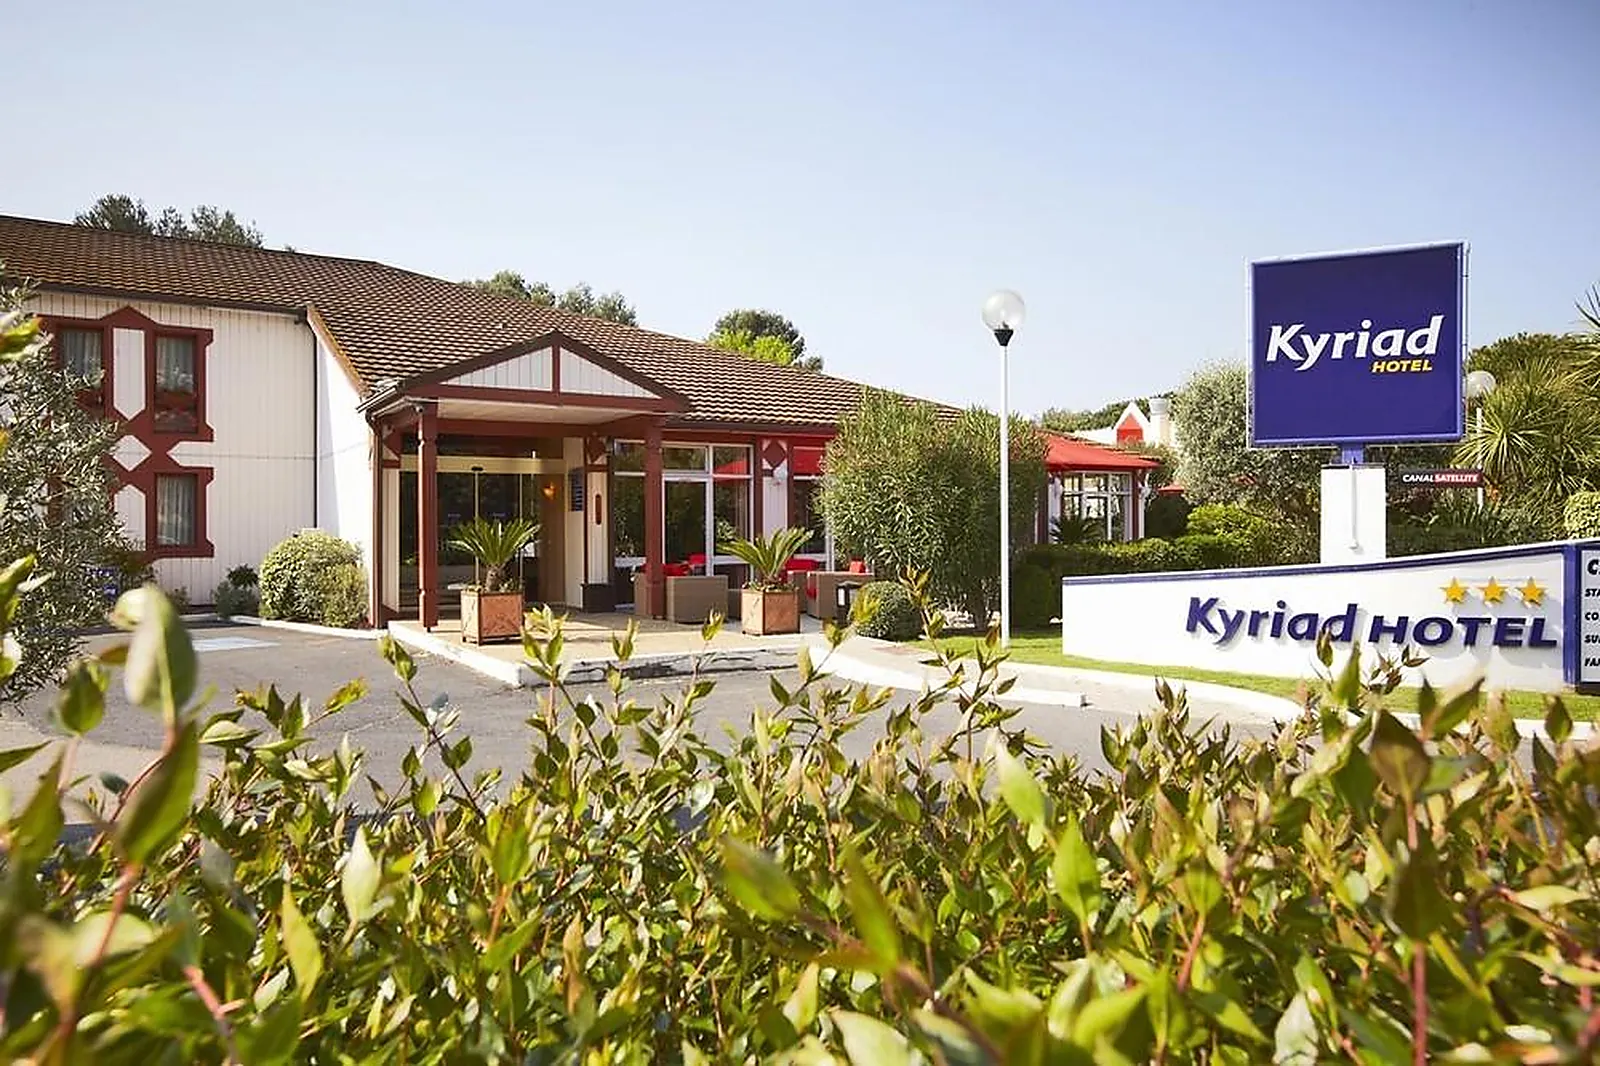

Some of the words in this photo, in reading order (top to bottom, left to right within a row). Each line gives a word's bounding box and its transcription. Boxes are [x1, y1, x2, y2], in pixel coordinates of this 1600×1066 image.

[1266, 315, 1444, 371] Kyriad
[1371, 359, 1433, 373] HOTEL
[1186, 596, 1358, 645] Kyriad
[1368, 615, 1557, 647] HOTEL
